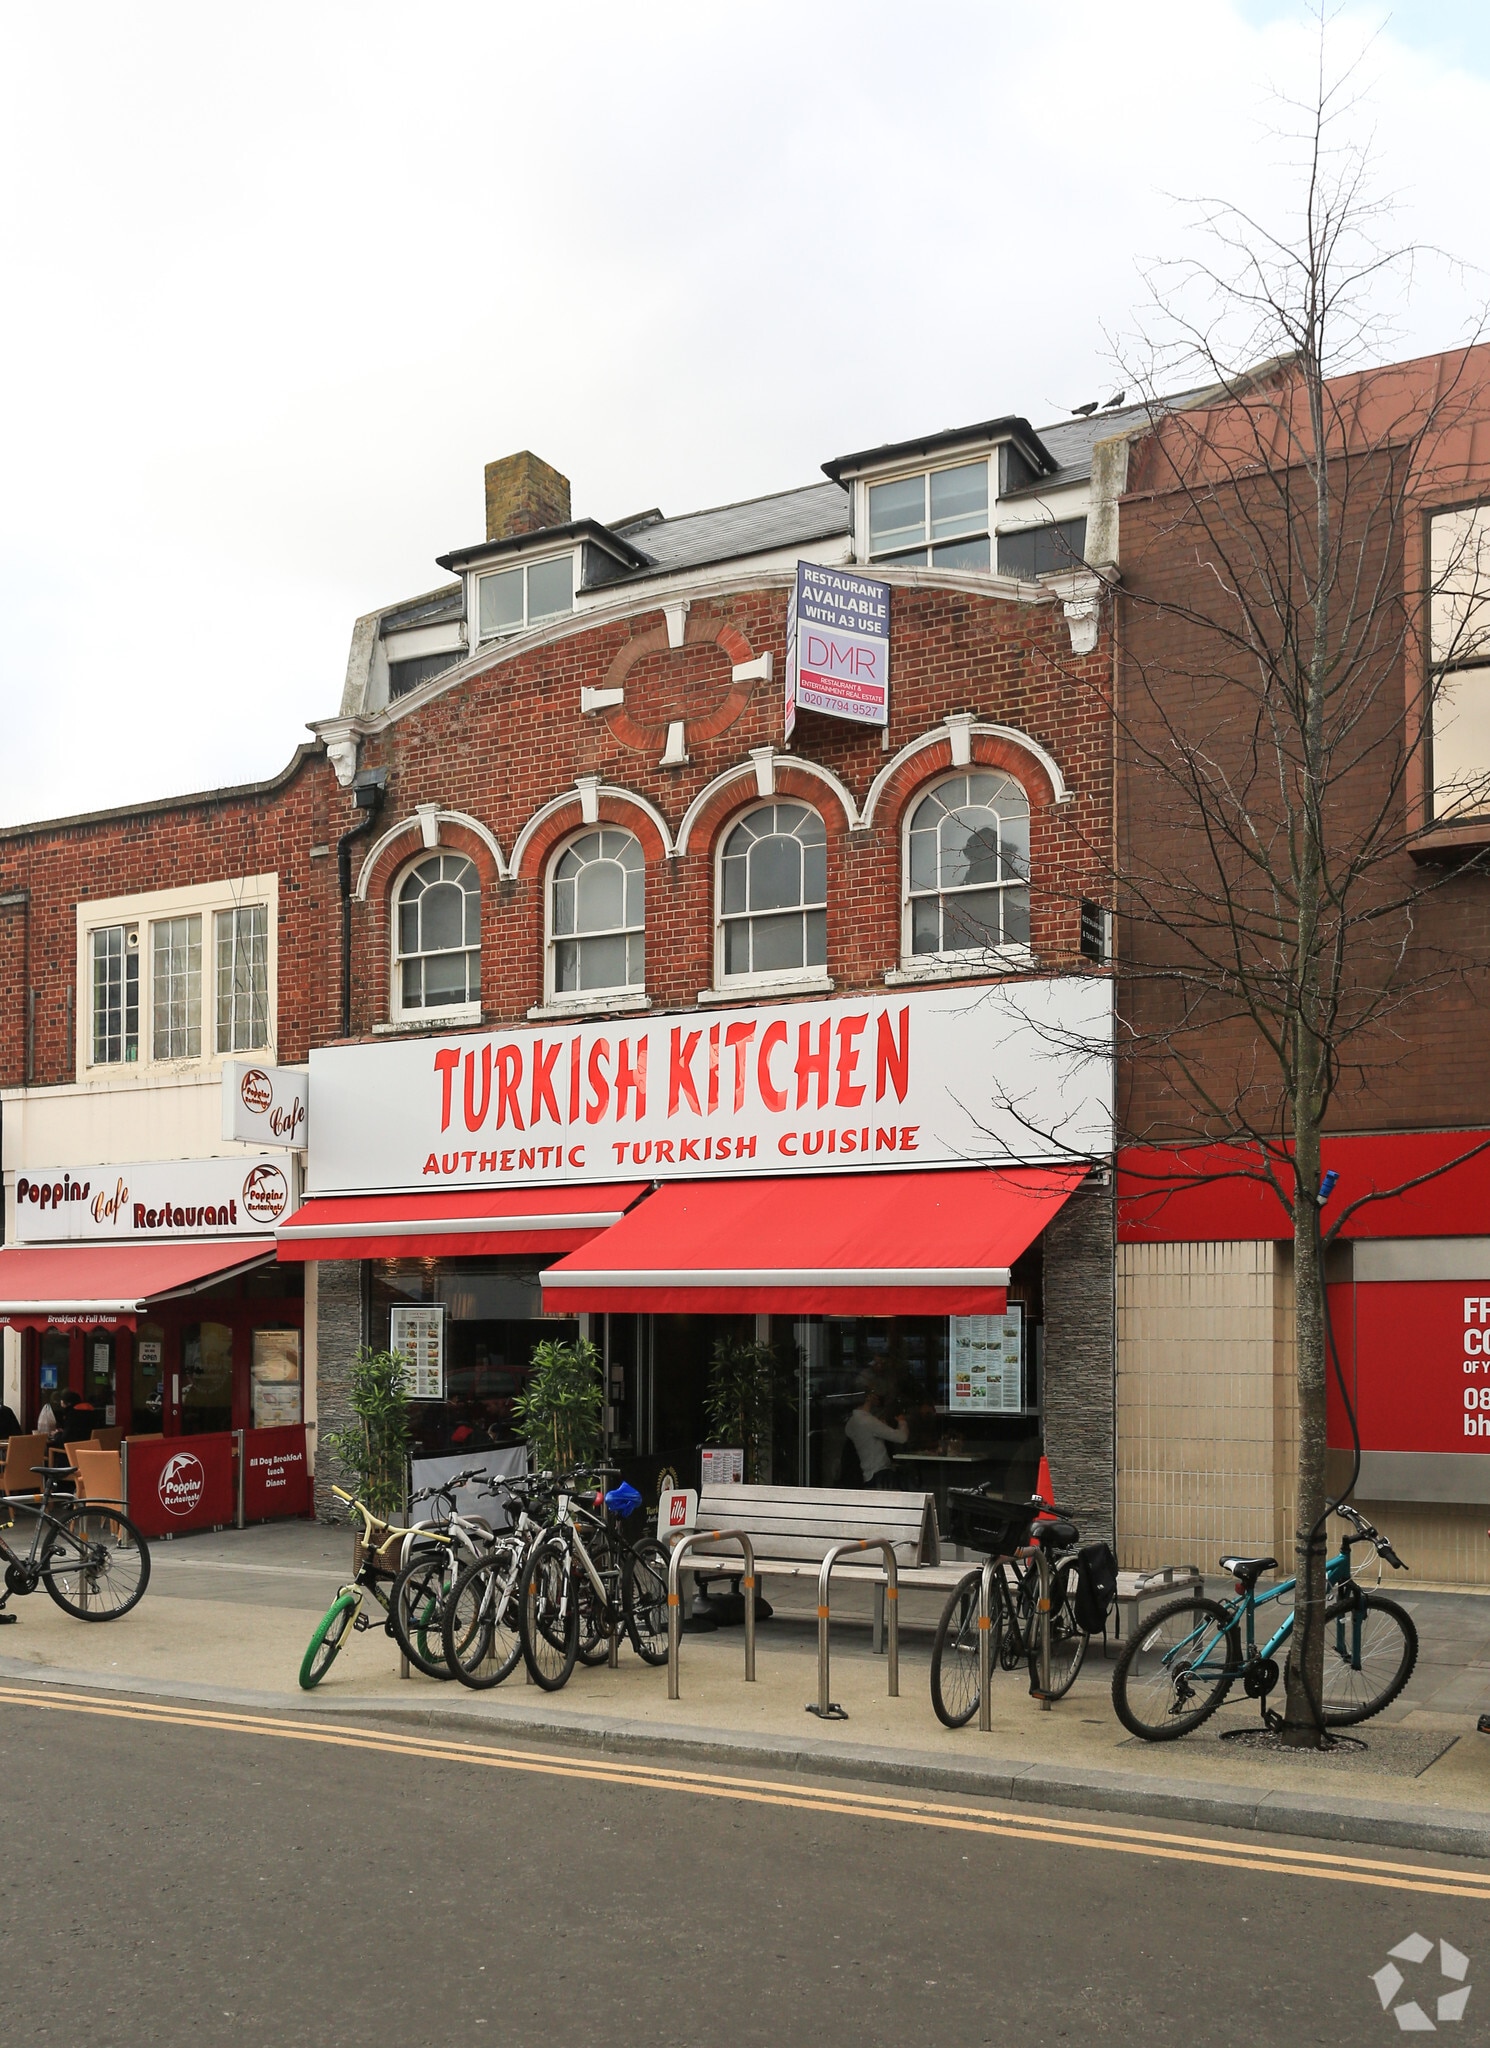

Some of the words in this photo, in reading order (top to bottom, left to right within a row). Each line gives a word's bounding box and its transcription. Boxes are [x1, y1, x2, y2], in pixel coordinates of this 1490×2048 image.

[804, 569, 883, 599] RESTAURANT
[802, 586, 886, 618] AVAILABLE
[805, 605, 835, 624] WITH
[838, 616, 855, 628] A3
[858, 619, 882, 633] USE
[808, 636, 876, 679] DMR
[801, 680, 845, 696] ENTERTAINMENT
[846, 689, 861, 698] REAL
[862, 692, 883, 703] ESTATE
[820, 677, 856, 690] RESTAURANT
[804, 692, 822, 706] 020
[825, 697, 849, 712] 7794
[853, 702, 878, 717] 9527
[434, 1033, 648, 1134] TURKISH
[667, 1004, 910, 1120] KITCHEN
[246, 1087, 270, 1099] Poppins
[269, 1096, 305, 1141] Cafe
[422, 1144, 586, 1175] AUTHENTIC
[612, 1135, 757, 1165] TURKISH
[777, 1125, 920, 1157] CUISINE
[17, 1173, 91, 1210] Poppins
[90, 1176, 129, 1225] Cafe
[133, 1199, 237, 1229] Restaurant
[250, 1188, 284, 1202] Poppins
[47, 1315, 76, 1324] Breakfast
[77, 1315, 84, 1323] &
[85, 1315, 97, 1323] Full
[99, 1315, 117, 1323] Menu
[1463, 1361, 1479, 1373] OF
[1464, 1413, 1490, 1436] bh
[259, 1457, 272, 1466] Day
[273, 1452, 302, 1464] Breakfast
[267, 1466, 285, 1476] Lunch
[166, 1478, 201, 1494] Poppins
[265, 1479, 286, 1488] Dinner
[671, 1501, 686, 1523] illy
